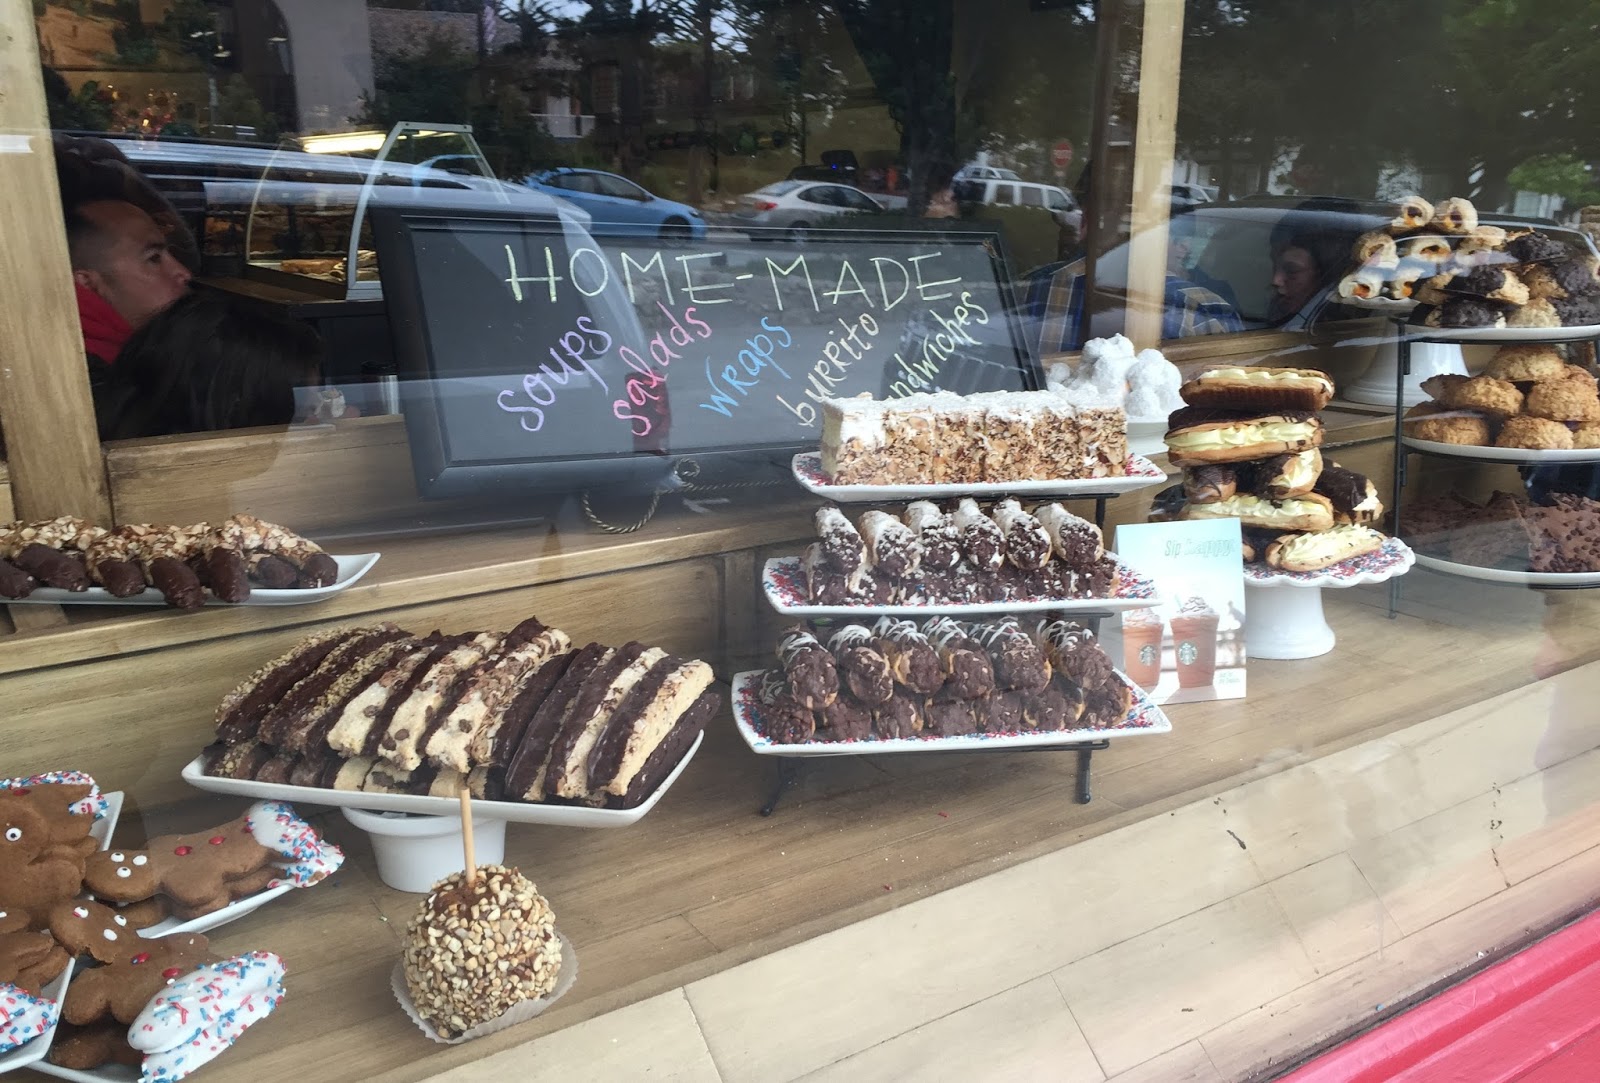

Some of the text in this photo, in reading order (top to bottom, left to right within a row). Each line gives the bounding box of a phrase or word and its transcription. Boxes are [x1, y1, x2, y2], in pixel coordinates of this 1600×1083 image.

[505, 243, 961, 312] HOME-MADE
[613, 300, 712, 436] salads
[888, 291, 989, 398] ndwiches
[1164, 540, 1182, 559] Sip
